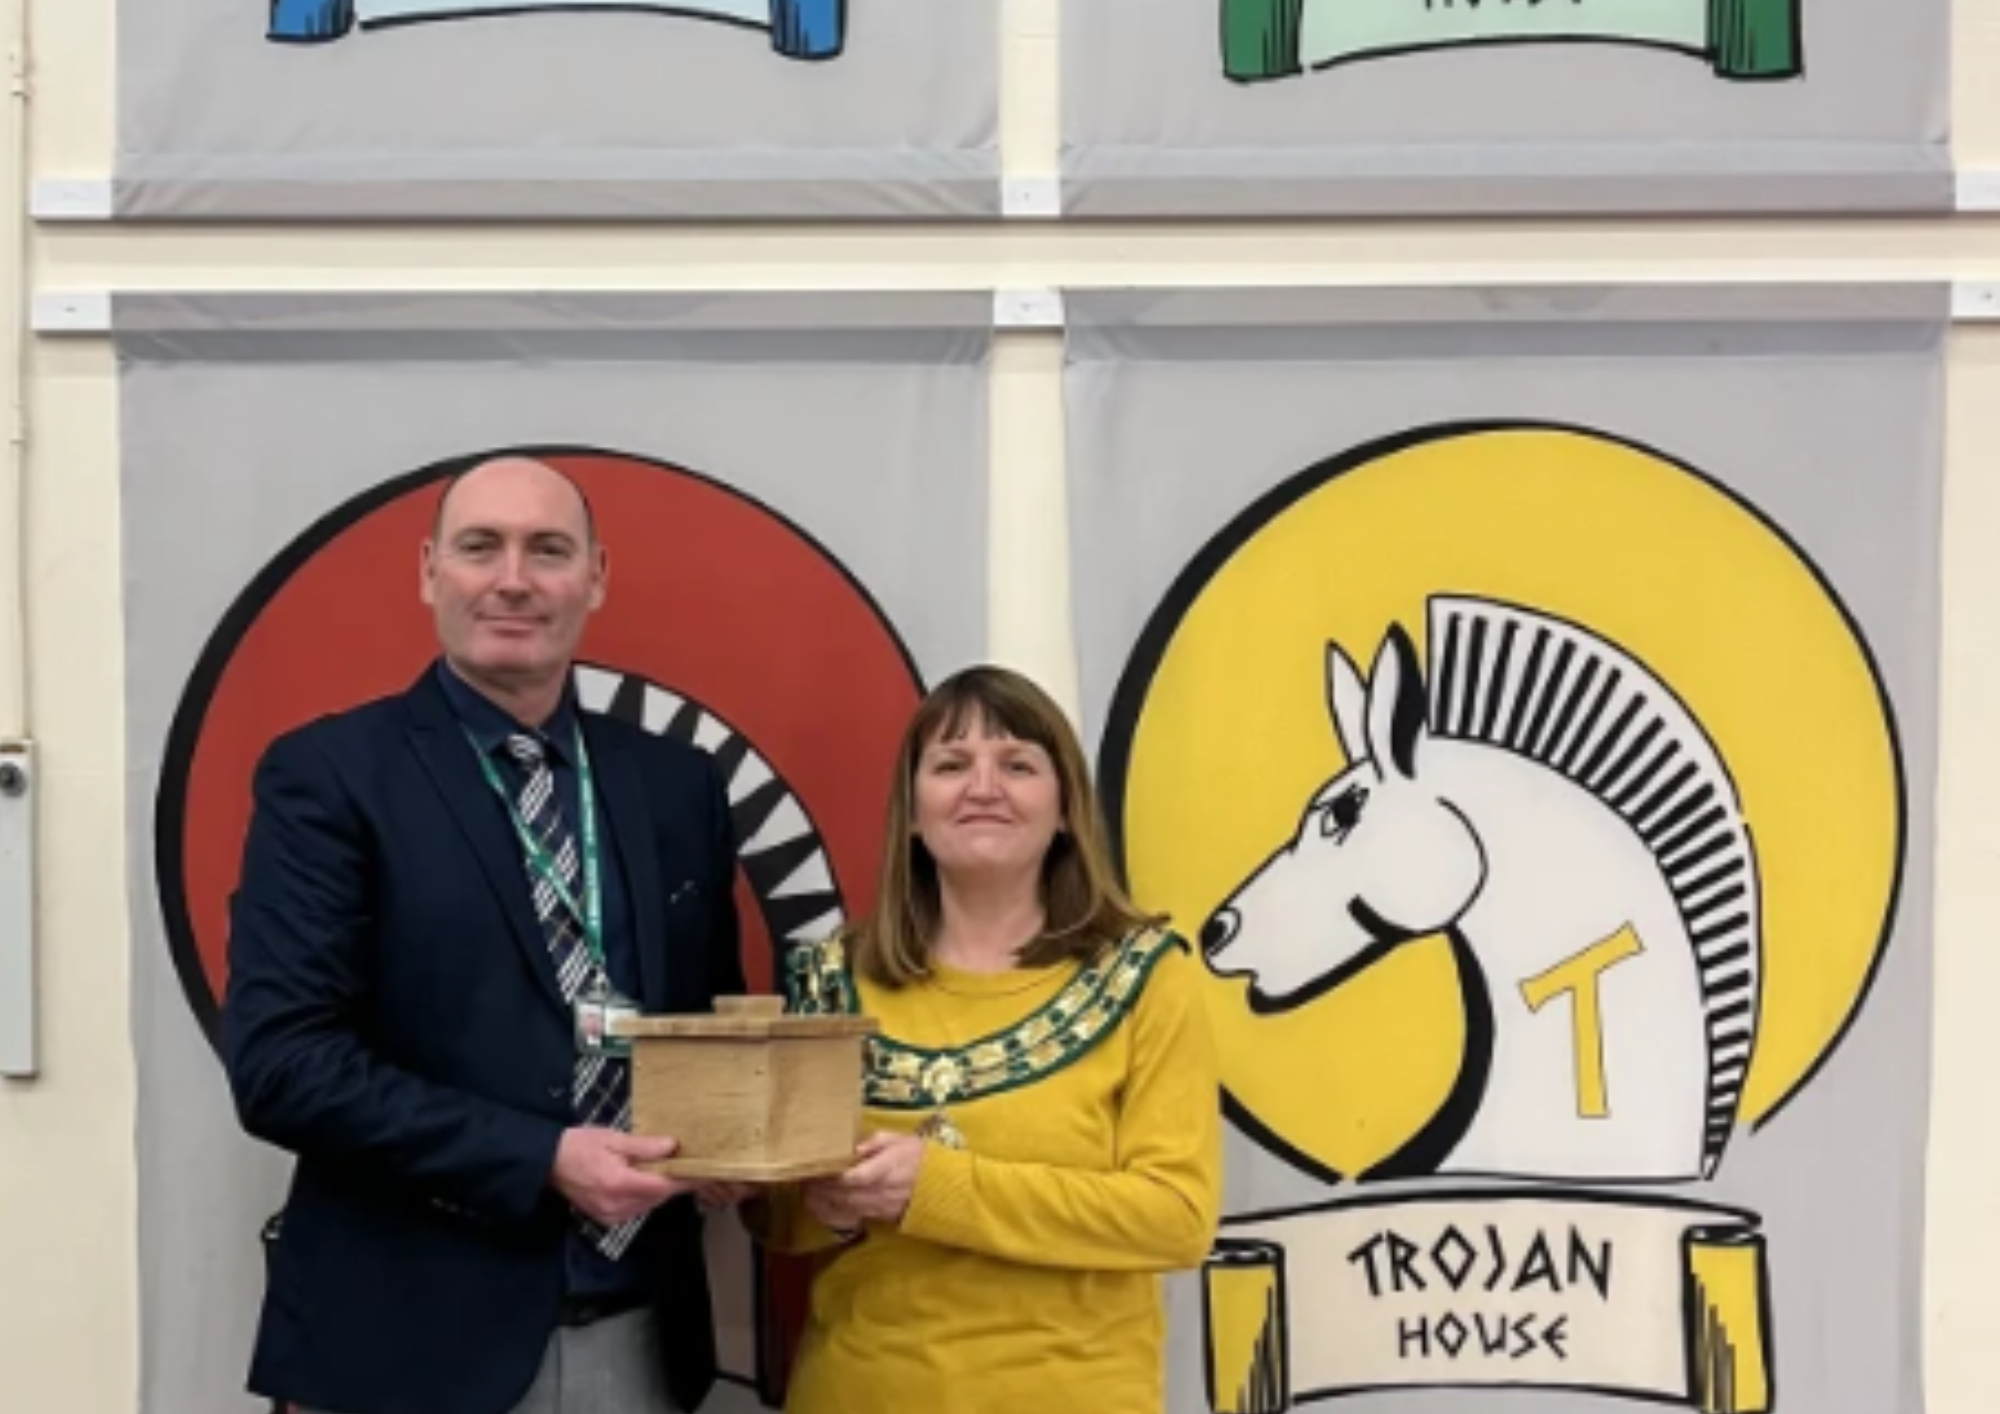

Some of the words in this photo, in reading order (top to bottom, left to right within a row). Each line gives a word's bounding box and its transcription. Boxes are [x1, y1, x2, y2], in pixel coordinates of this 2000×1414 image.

[1518, 920, 1645, 1118] T
[1346, 1224, 1612, 1300] TROJAN
[1398, 1311, 1568, 1359] HOUSE
